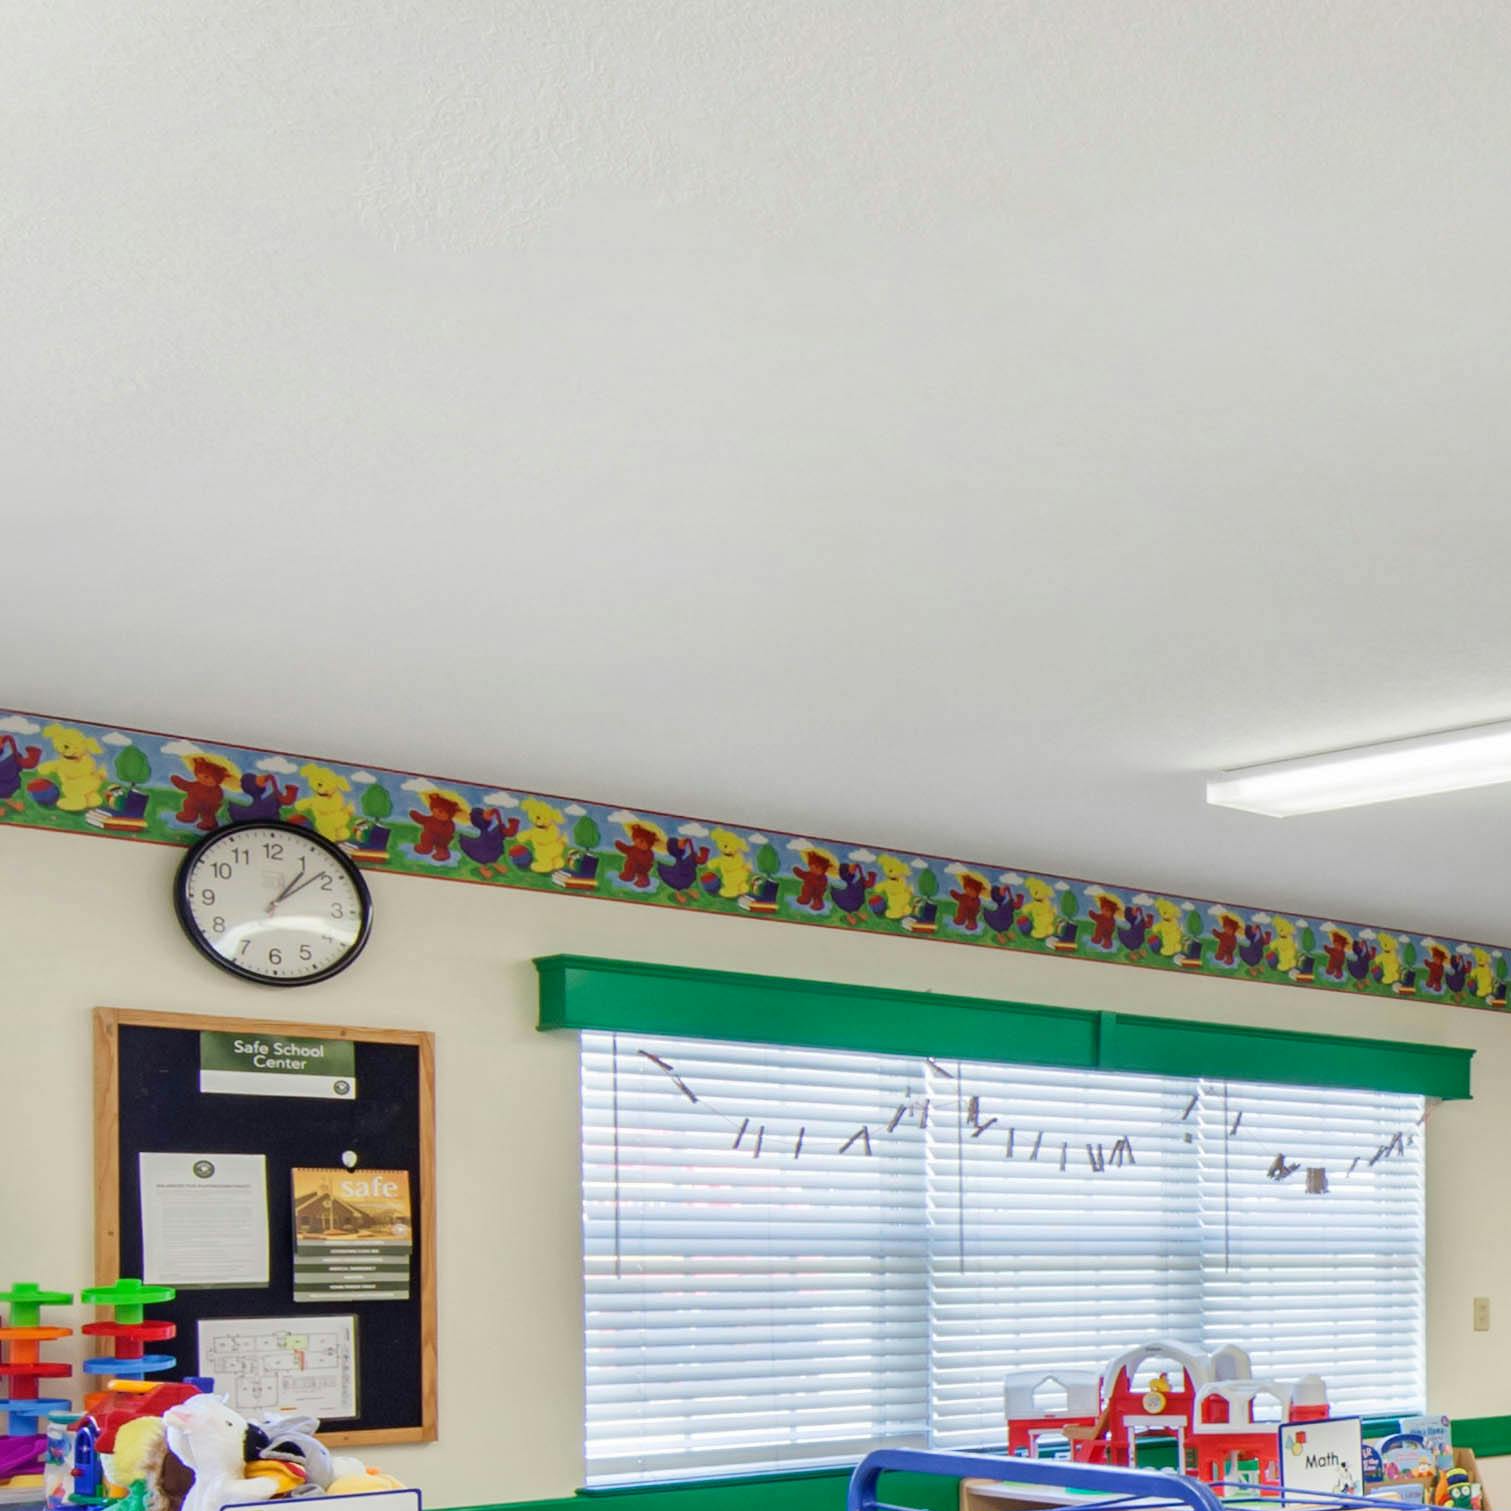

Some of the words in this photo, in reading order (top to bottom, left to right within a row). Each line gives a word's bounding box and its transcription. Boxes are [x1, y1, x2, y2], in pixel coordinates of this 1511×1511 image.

[232, 847, 249, 865] 11
[264, 843, 284, 860] 12
[212, 862, 232, 880] 10
[299, 856, 306, 872] 1
[320, 875, 333, 891] 2
[202, 889, 215, 905] 9
[331, 902, 343, 919] 3
[212, 916, 226, 933] 8
[240, 939, 251, 955] 7
[299, 944, 312, 960] 5
[269, 948, 282, 965] 6
[233, 1039, 269, 1055] Safe
[273, 1042, 324, 1058] School
[253, 1055, 307, 1070] Center
[340, 1176, 399, 1198] safe
[1305, 1452, 1339, 1469] Math
